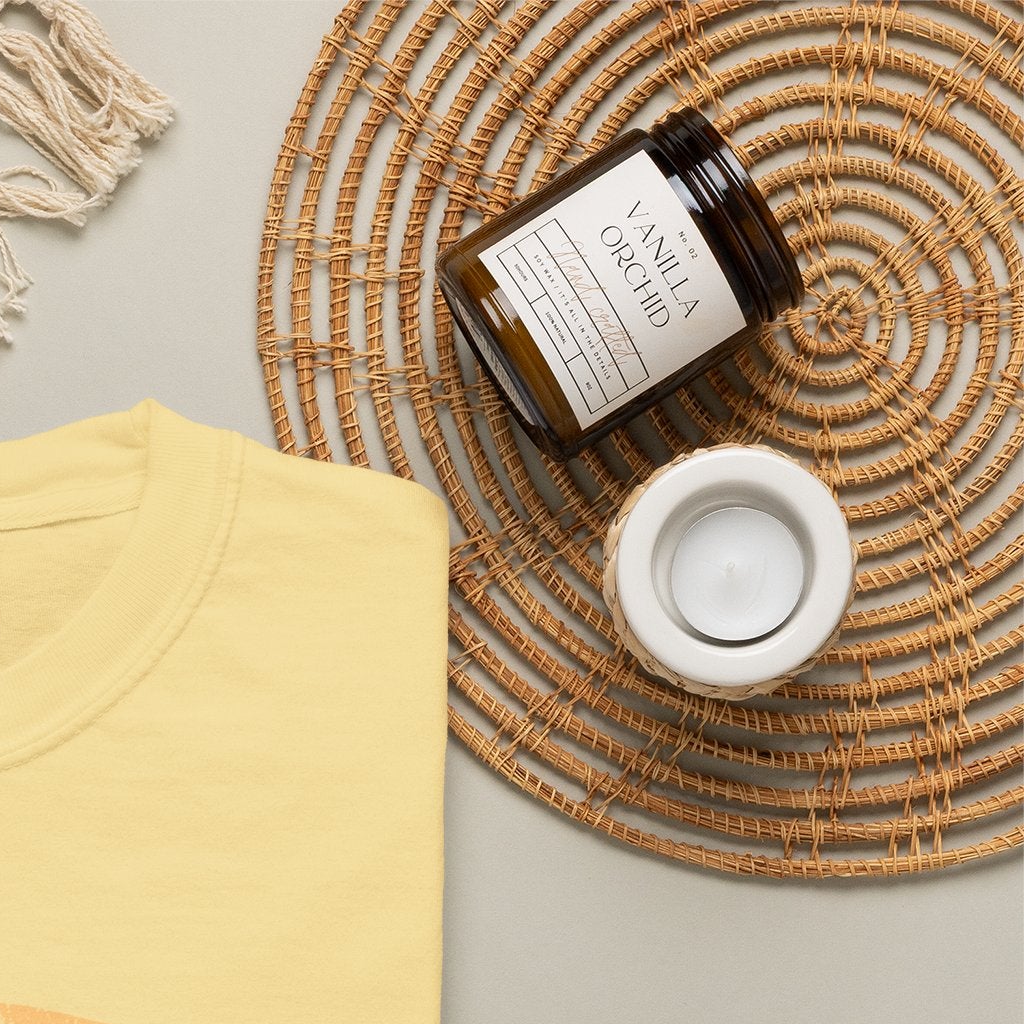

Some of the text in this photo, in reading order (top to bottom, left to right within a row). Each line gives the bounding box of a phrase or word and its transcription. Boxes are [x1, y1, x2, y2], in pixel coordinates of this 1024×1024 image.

[600, 225, 670, 328] ORCHID
[626, 199, 700, 319] VANILLA
[677, 230, 698, 260] No. 02
[533, 254, 545, 267] SOY
[543, 268, 555, 284] WAX
[568, 308, 579, 323] ALL
[578, 324, 586, 334] IN
[584, 335, 596, 350] THE
[593, 351, 611, 380] DETAILS
